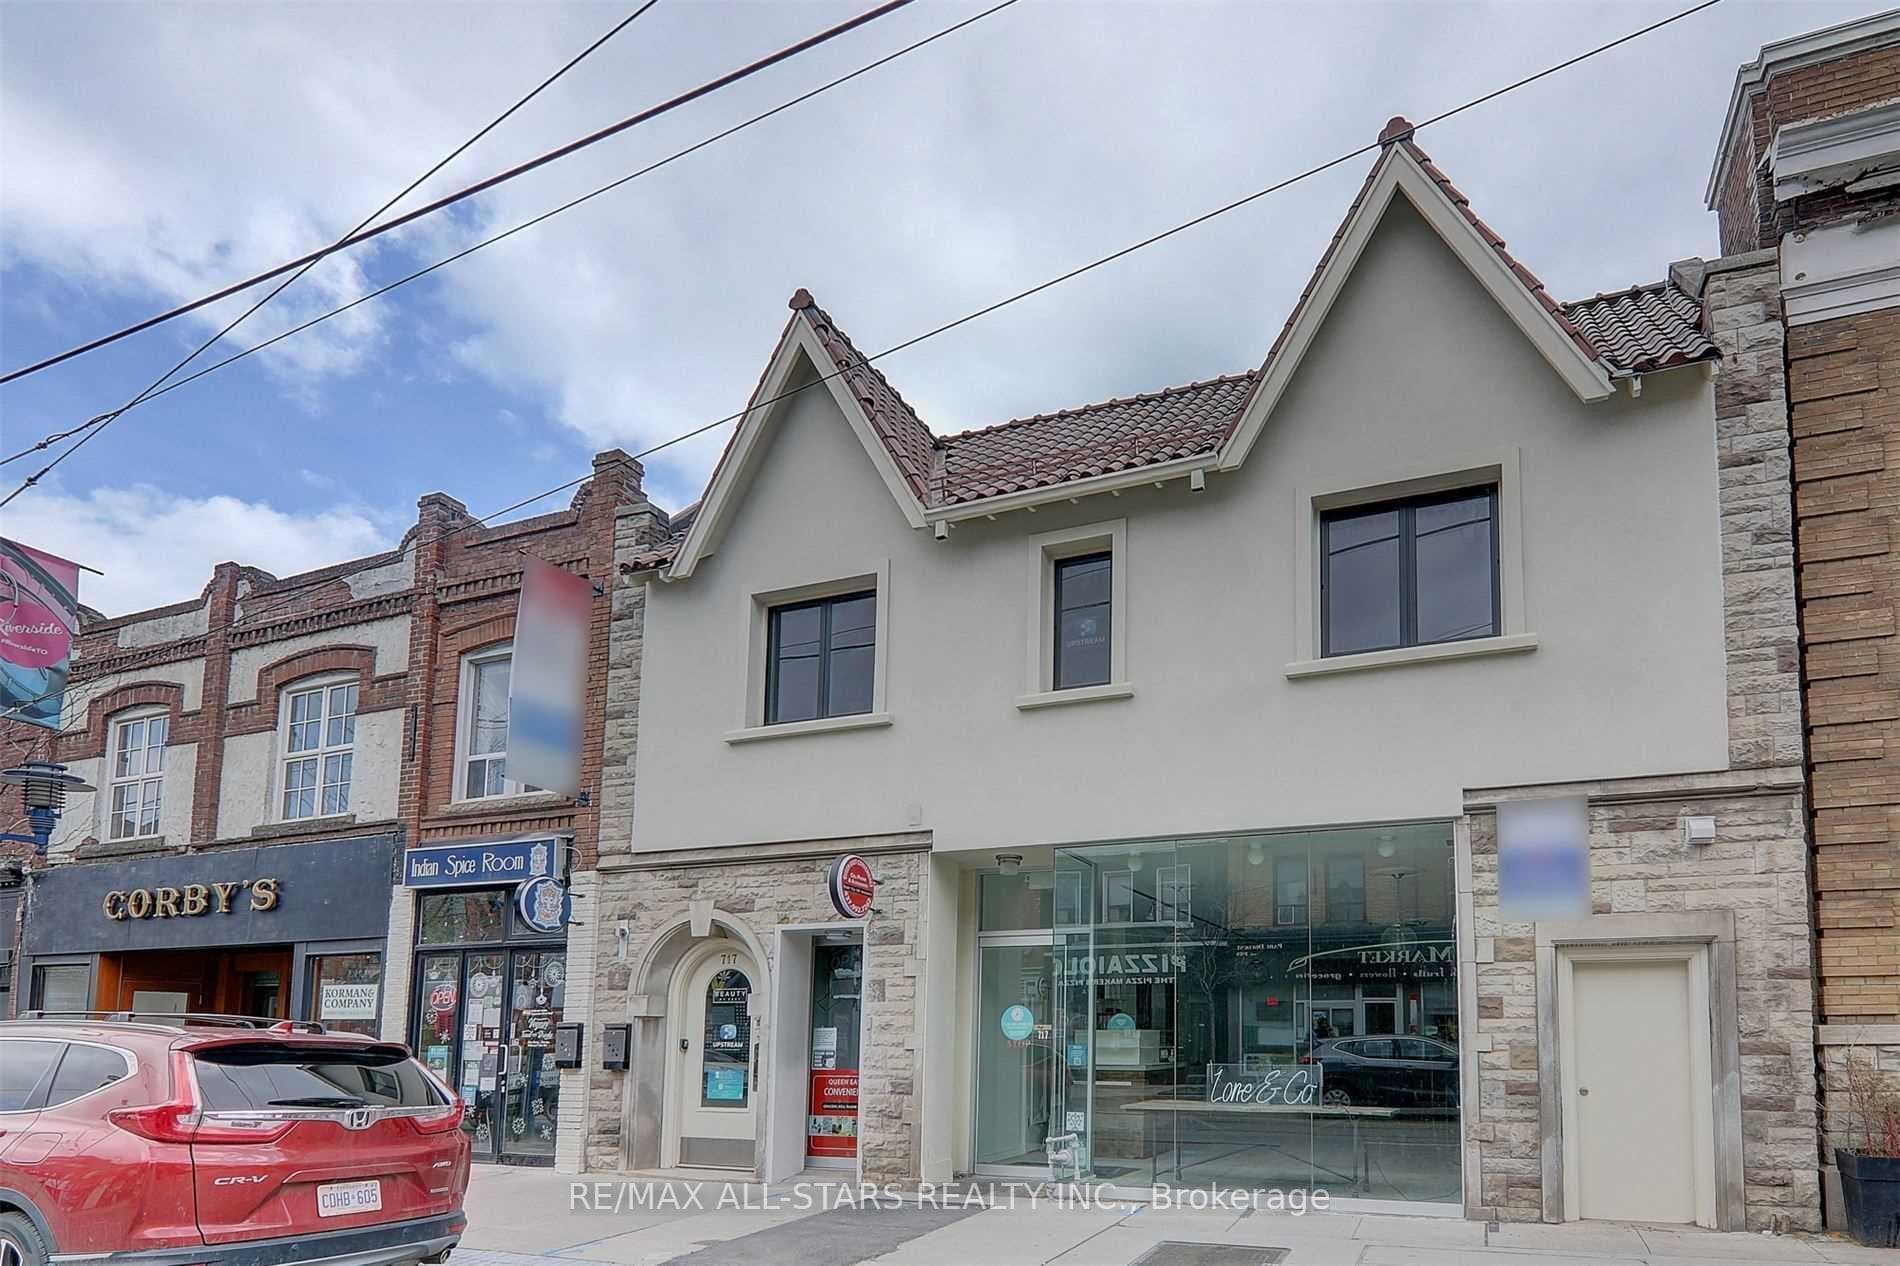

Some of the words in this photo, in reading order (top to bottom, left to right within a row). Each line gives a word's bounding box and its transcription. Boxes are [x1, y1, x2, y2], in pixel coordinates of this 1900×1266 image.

[411, 858, 439, 877] Indian
[445, 854, 476, 878] Spice
[482, 851, 525, 873] Room
[103, 877, 281, 921] CORBY'S
[720, 953, 738, 965] 717
[324, 999, 375, 1009] COMPANY
[431, 991, 457, 1005] OPEN
[1037, 1030, 1049, 1040] 717
[712, 1041, 744, 1049] UPSTREAM
[828, 1078, 849, 1086] QUEEN
[849, 1078, 860, 1086] EA
[1255, 1069, 1282, 1104] &
[1283, 1070, 1318, 1105] Co
[214, 1174, 270, 1186] CR-V
[356, 1188, 378, 1205] 605
